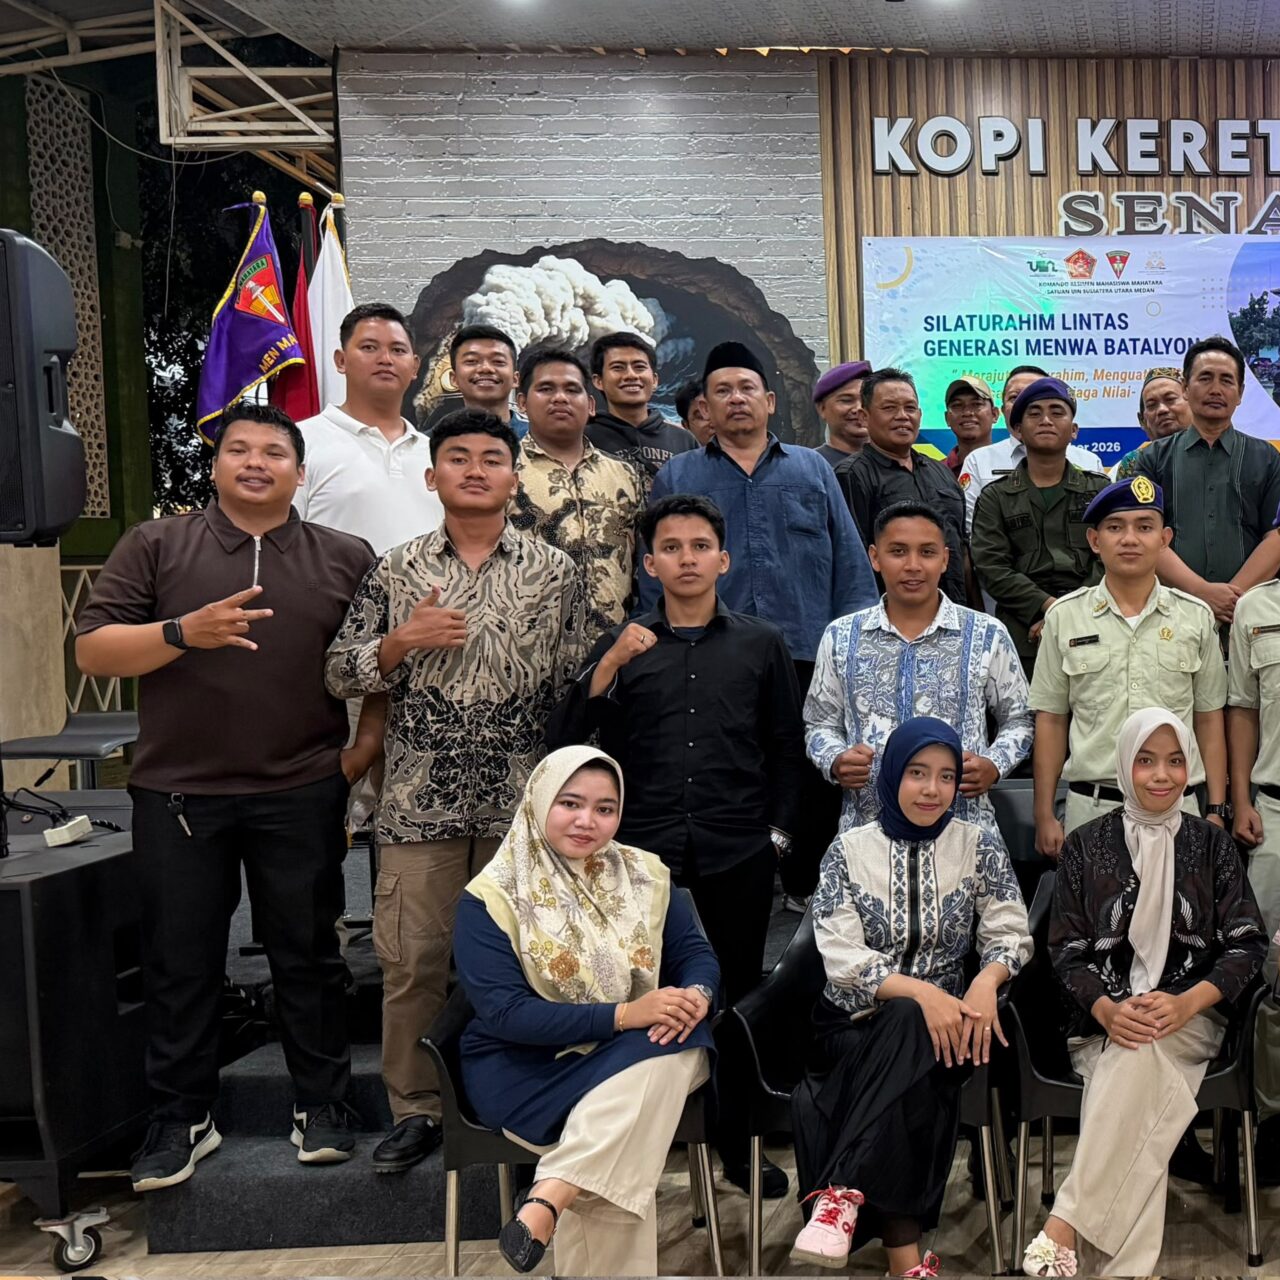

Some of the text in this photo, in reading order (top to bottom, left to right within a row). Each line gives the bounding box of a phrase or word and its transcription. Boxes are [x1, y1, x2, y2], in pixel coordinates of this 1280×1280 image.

[873, 116, 1046, 176] KOPI
[923, 312, 1129, 333] SILATURAHIM LINTAS
[923, 337, 1200, 357] GENERASI MENWA BATALYON
[1102, 385, 1136, 399] Nilai-
[1091, 442, 1121, 452] 2026
